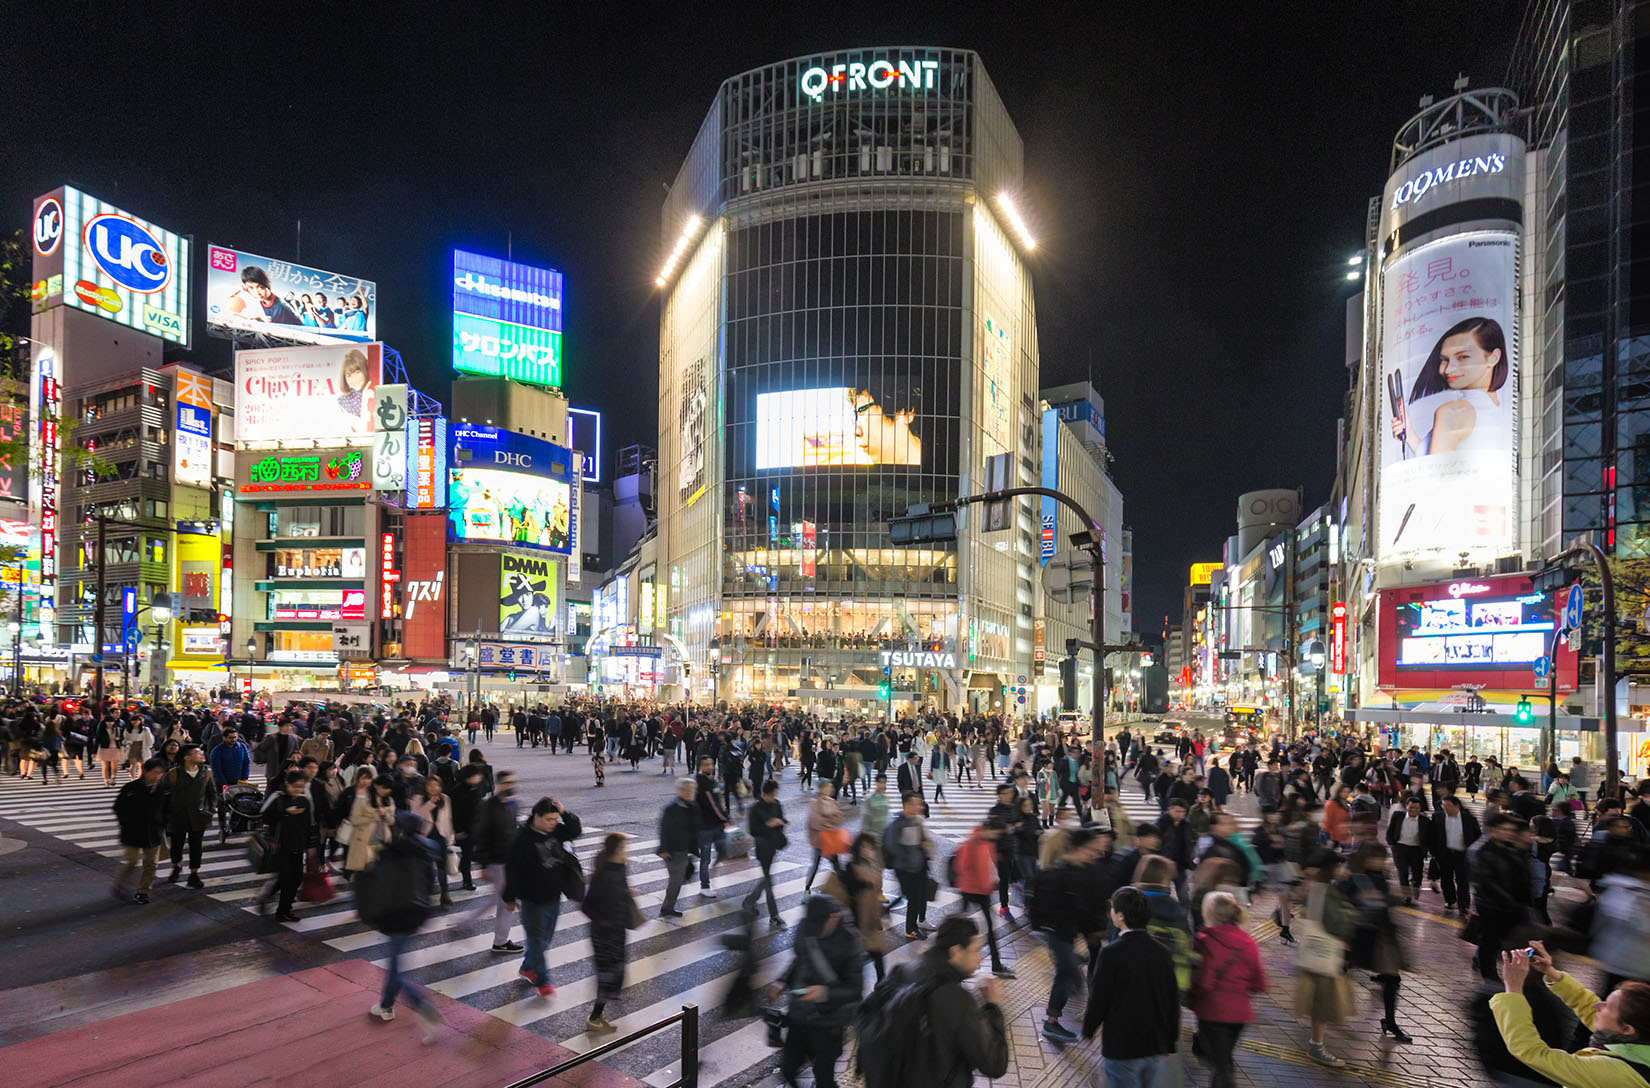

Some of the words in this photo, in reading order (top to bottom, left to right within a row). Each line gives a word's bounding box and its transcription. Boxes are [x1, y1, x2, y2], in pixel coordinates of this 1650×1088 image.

[801, 60, 938, 102] QFRONT
[36, 211, 62, 242] UC
[96, 224, 166, 281] UC
[1468, 240, 1511, 249] Panasonic
[267, 261, 376, 301] 朝から全力。
[147, 311, 180, 331] VISA
[459, 331, 557, 368] サロンパス
[376, 395, 405, 487] もんじゃ
[455, 430, 470, 438] DHC
[471, 431, 498, 439] Channel
[418, 421, 432, 503] 三千里薬品
[494, 450, 532, 468] DHC
[281, 463, 319, 481] 西村
[277, 565, 341, 578] Euphoria
[503, 555, 548, 577] DMM
[503, 572, 534, 592] FX
[881, 651, 955, 668] TSUTAYA
